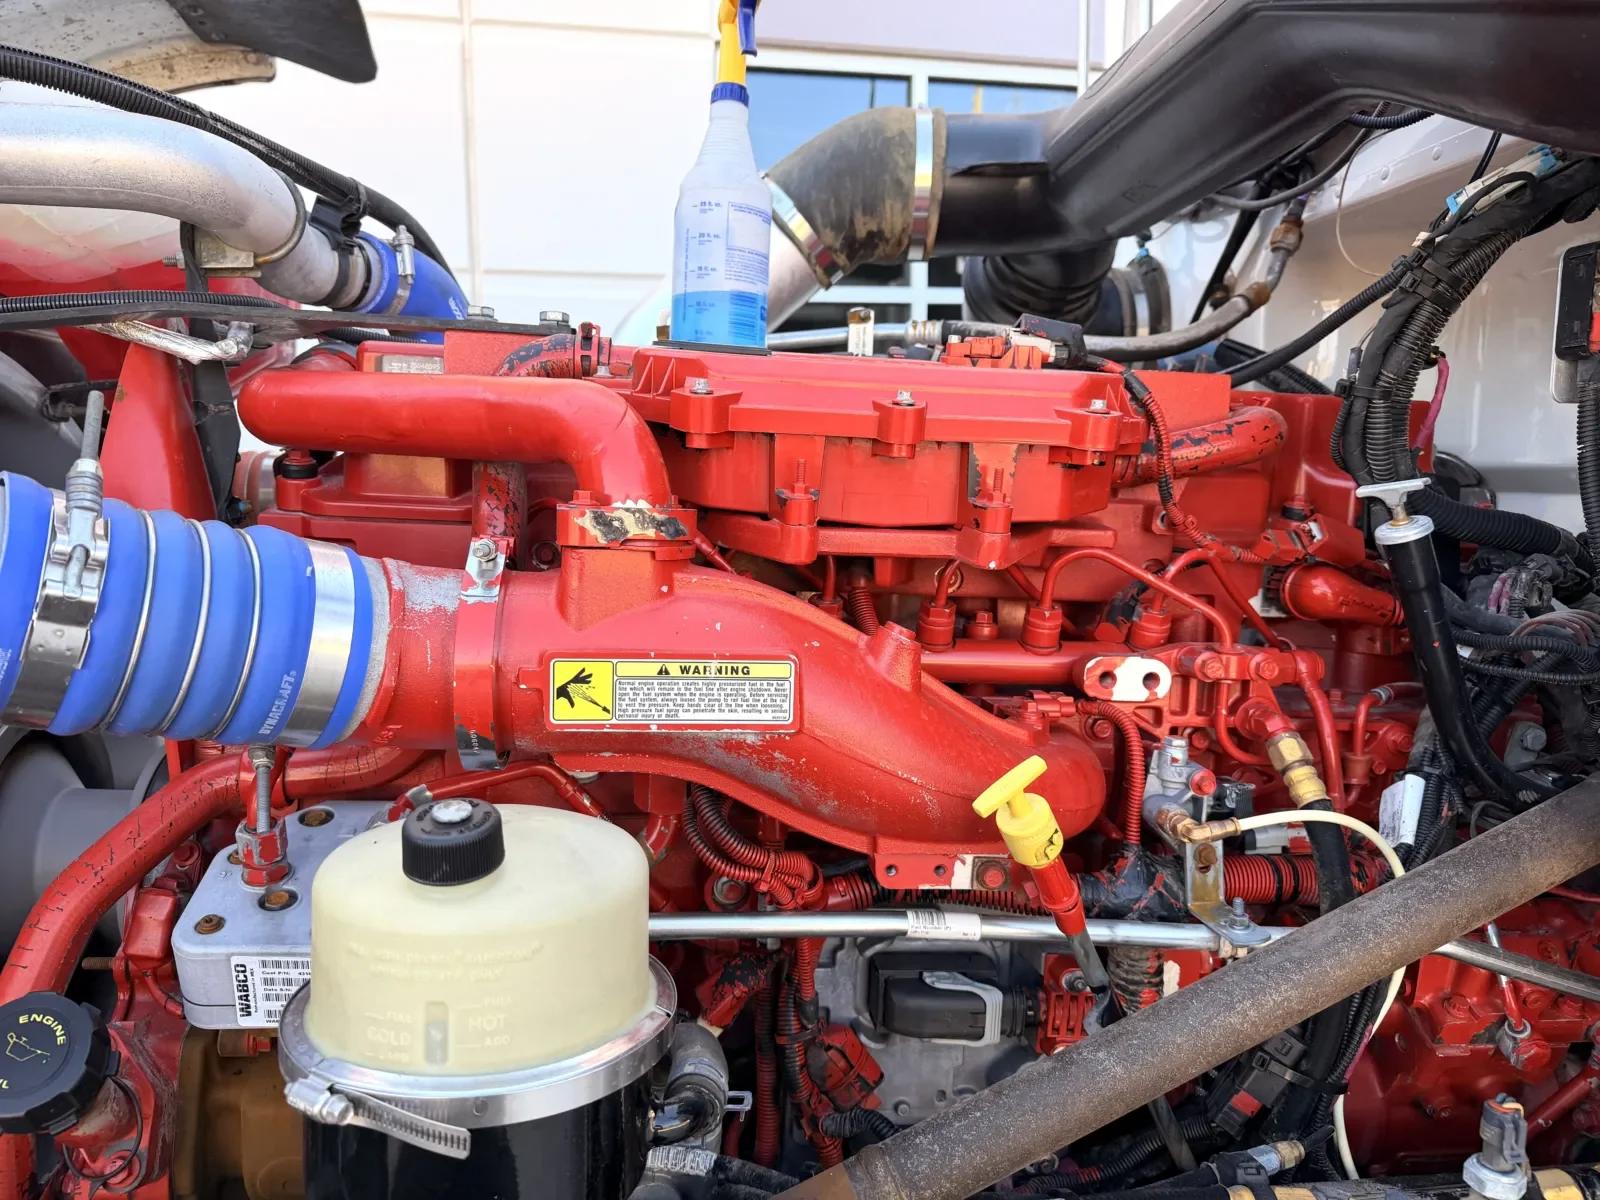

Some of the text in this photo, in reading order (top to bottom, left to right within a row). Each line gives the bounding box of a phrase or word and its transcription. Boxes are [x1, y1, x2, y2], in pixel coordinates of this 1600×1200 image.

[679, 665, 751, 676] WARNING
[234, 963, 252, 1018] WABCO
[18, 1013, 67, 1047] ENGINE
[468, 1013, 506, 1032] HOT
